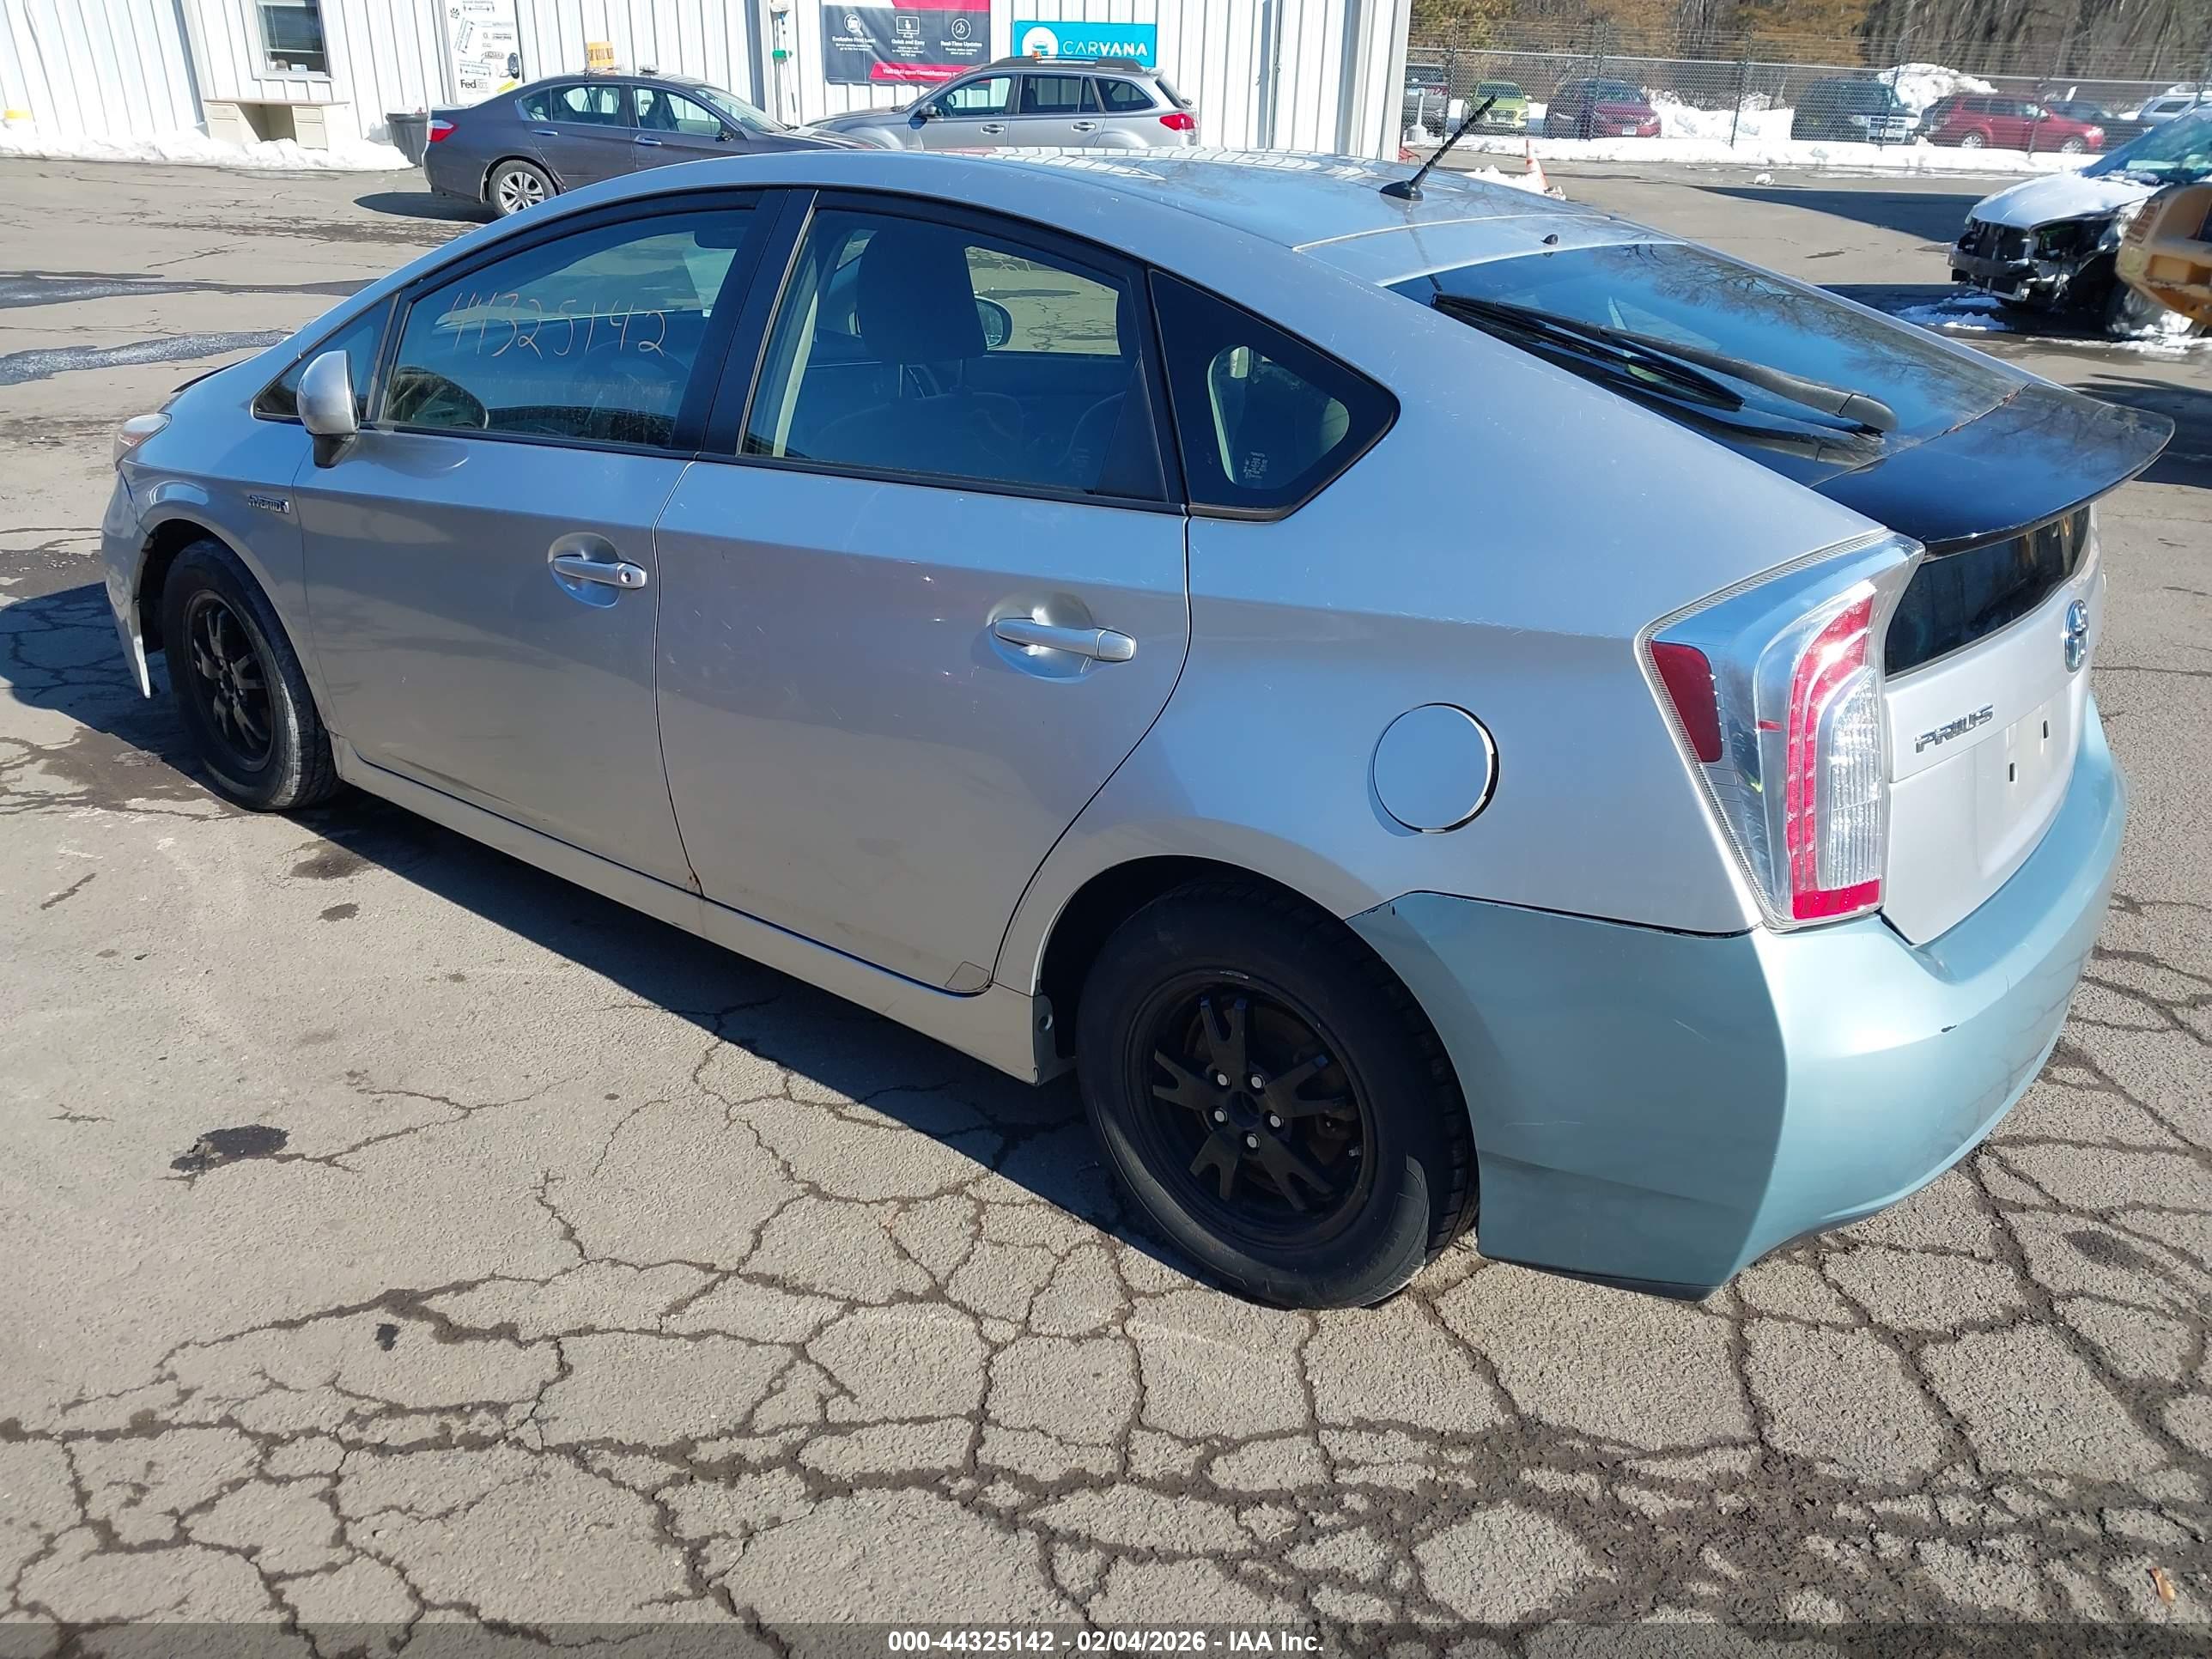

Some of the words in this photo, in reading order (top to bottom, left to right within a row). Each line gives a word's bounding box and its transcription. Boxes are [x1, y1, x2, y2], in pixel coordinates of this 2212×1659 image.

[1062, 40, 1147, 56] CARVANA
[451, 292, 665, 360] 44325142
[1914, 703, 1994, 754] PRIUS
